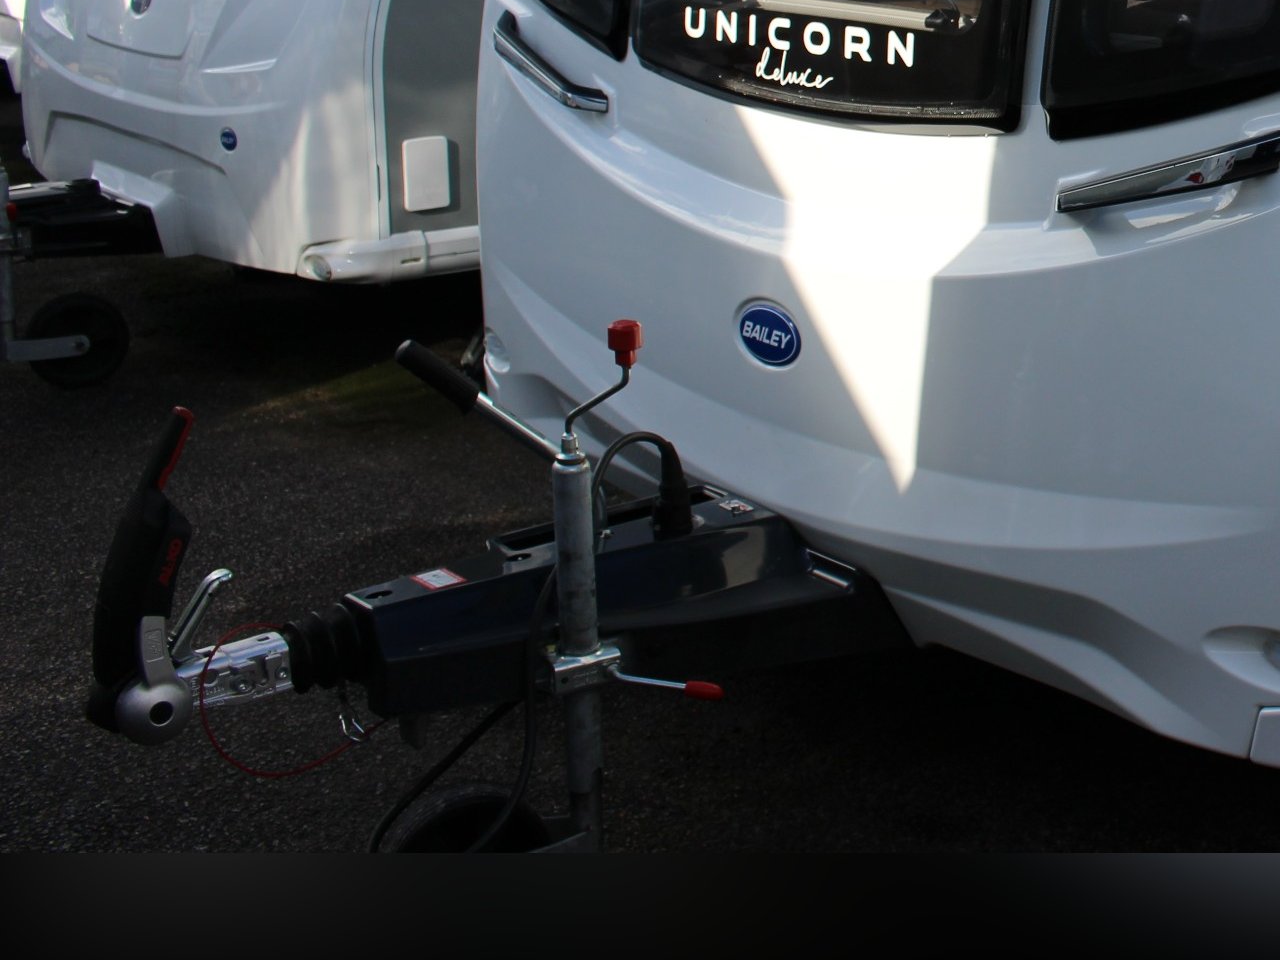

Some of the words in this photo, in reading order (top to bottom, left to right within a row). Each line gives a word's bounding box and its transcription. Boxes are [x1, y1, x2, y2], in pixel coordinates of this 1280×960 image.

[684, 6, 915, 68] UNICORN
[755, 47, 834, 89] deluxe
[742, 320, 791, 349] BAILEY
